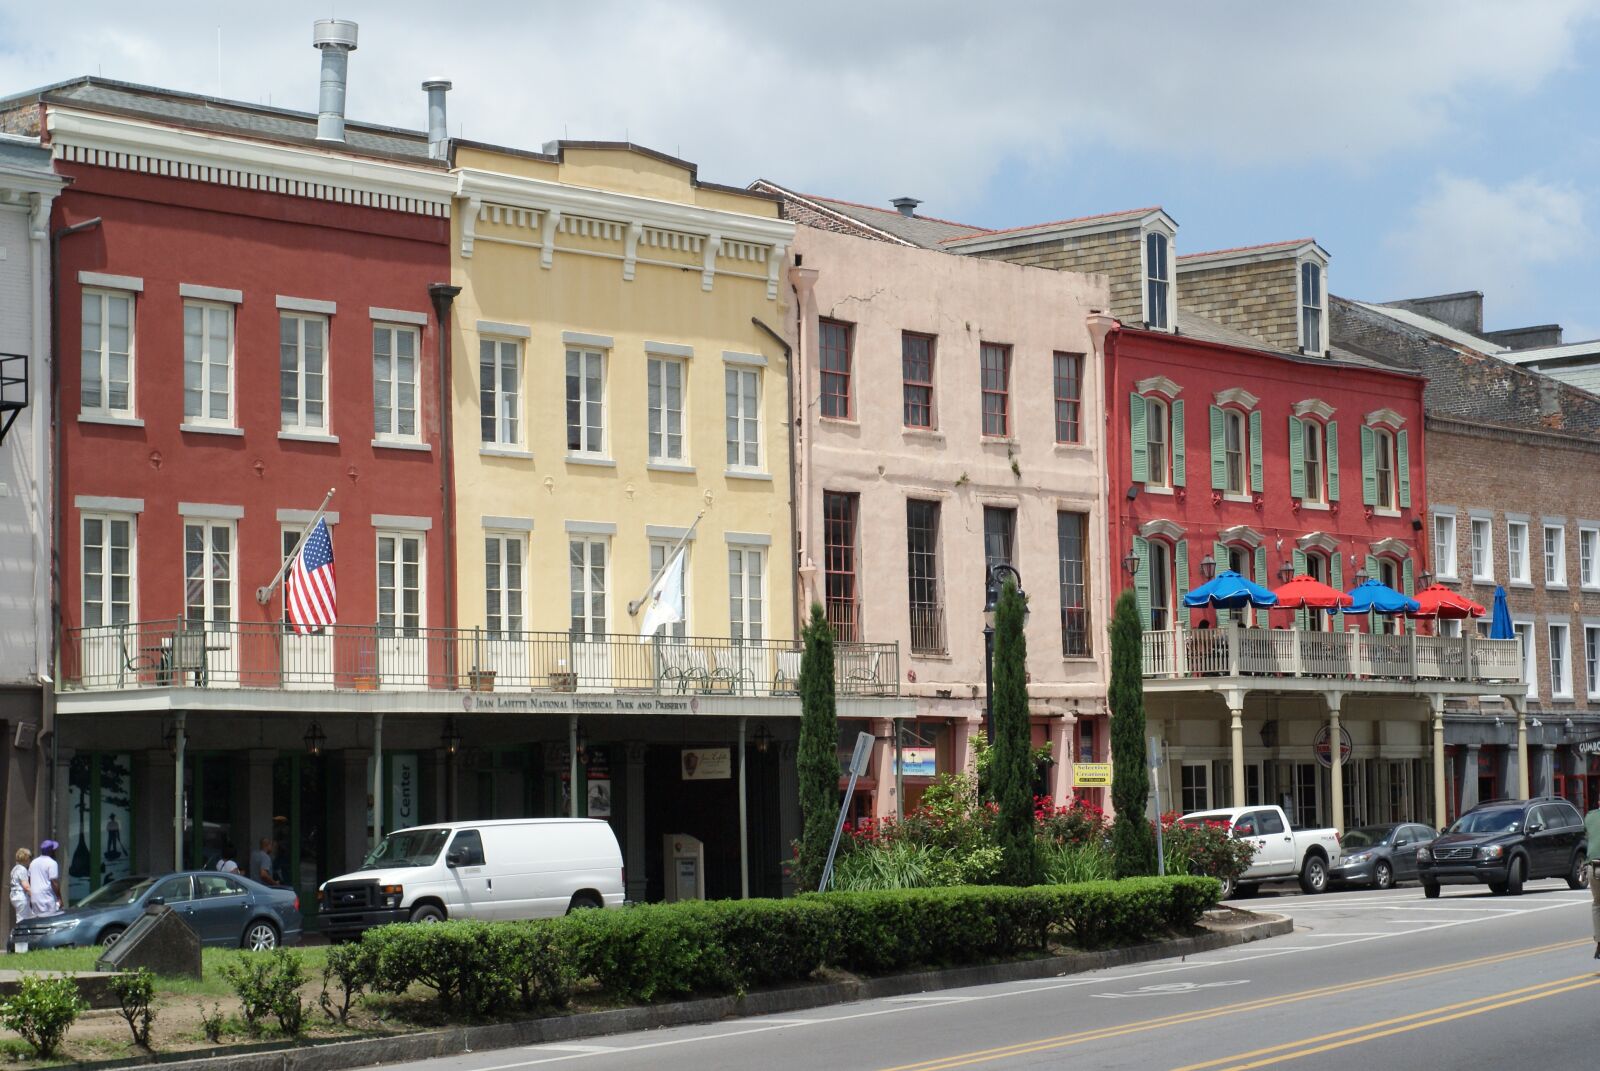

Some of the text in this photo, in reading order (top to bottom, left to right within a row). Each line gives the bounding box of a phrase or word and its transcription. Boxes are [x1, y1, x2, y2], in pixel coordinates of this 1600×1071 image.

[475, 697, 688, 710] JEAN LAFITTE NATIONAL HISTORICAL PARK AND PRESERVE
[400, 763, 411, 818] Center
